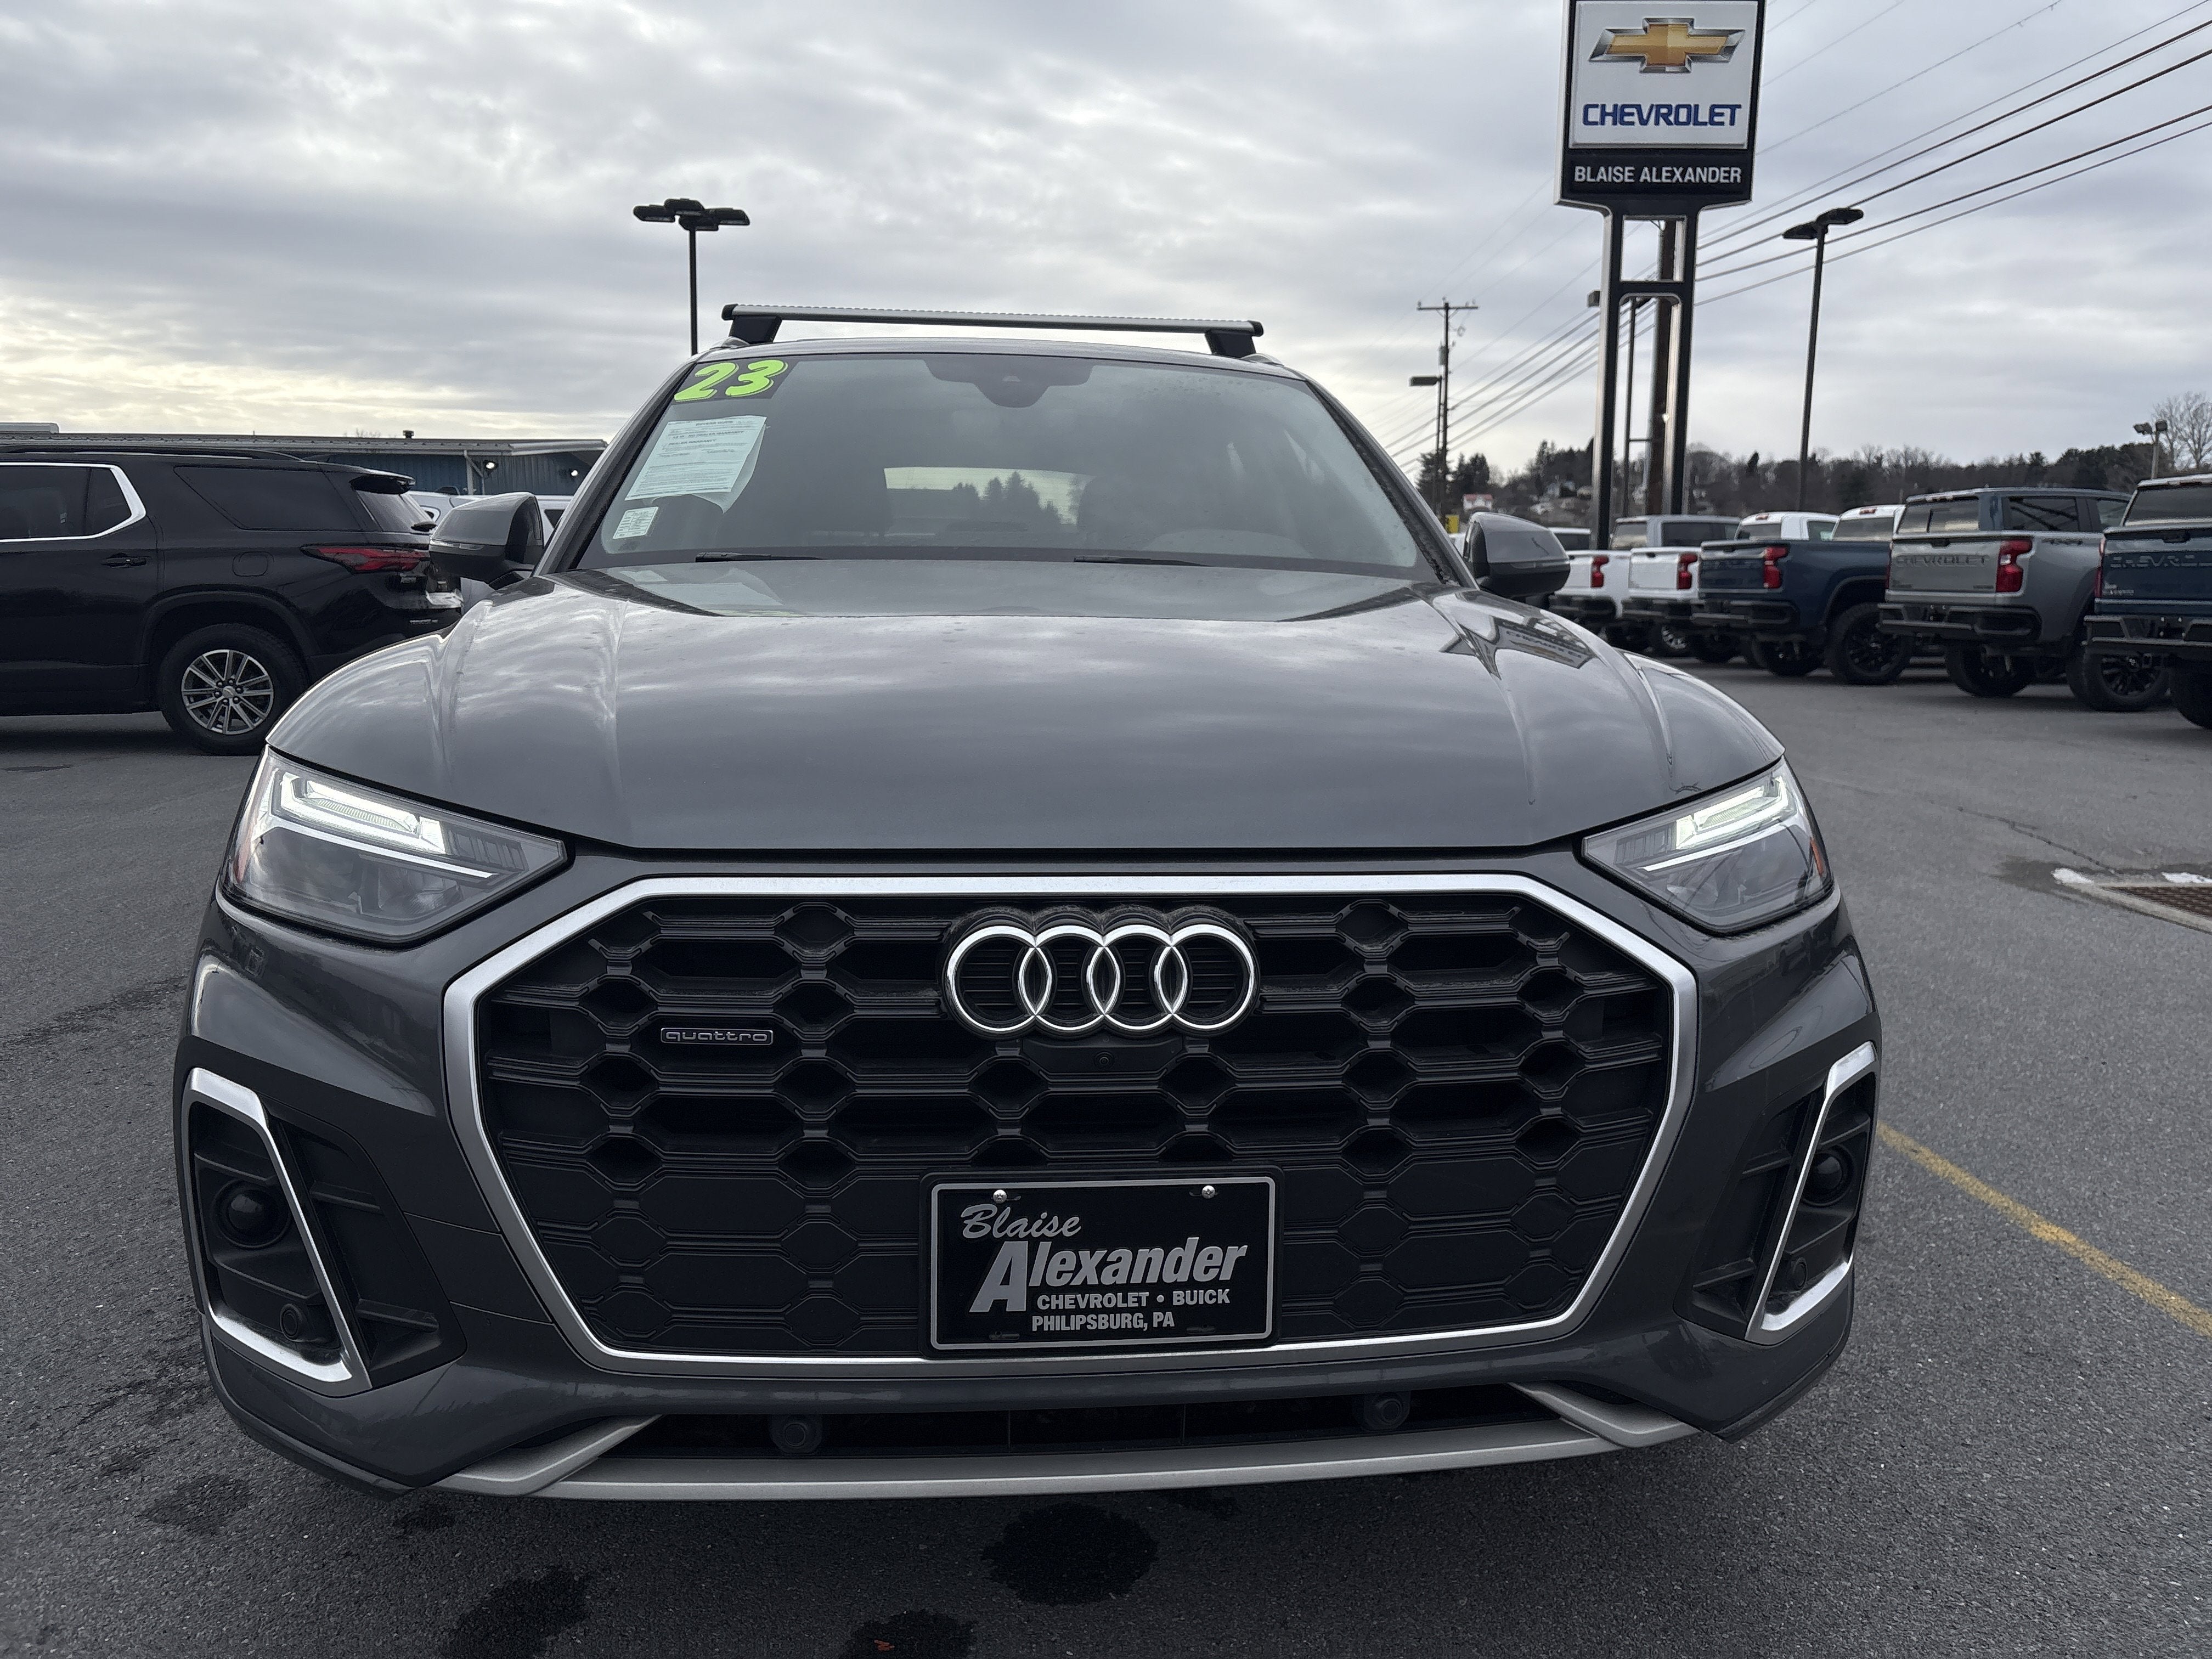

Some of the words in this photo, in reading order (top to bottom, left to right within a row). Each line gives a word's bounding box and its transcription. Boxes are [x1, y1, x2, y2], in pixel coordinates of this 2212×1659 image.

[1582, 104, 1742, 126] CHEVROLET
[1575, 166, 1635, 183] BLAISE
[1639, 167, 1742, 183] ALEXANDER
[674, 359, 788, 402] 23
[1896, 555, 1989, 567] CHEVROLET
[665, 1031, 768, 1042] quattro
[961, 1204, 1081, 1238] Blaise
[969, 1237, 1248, 1312] Alexander
[1037, 1291, 1149, 1310] CHEVROLET
[1172, 1289, 1230, 1306] BUICK
[1032, 1312, 1148, 1332] PHILIPSBURG,
[1153, 1312, 1175, 1328] PA
